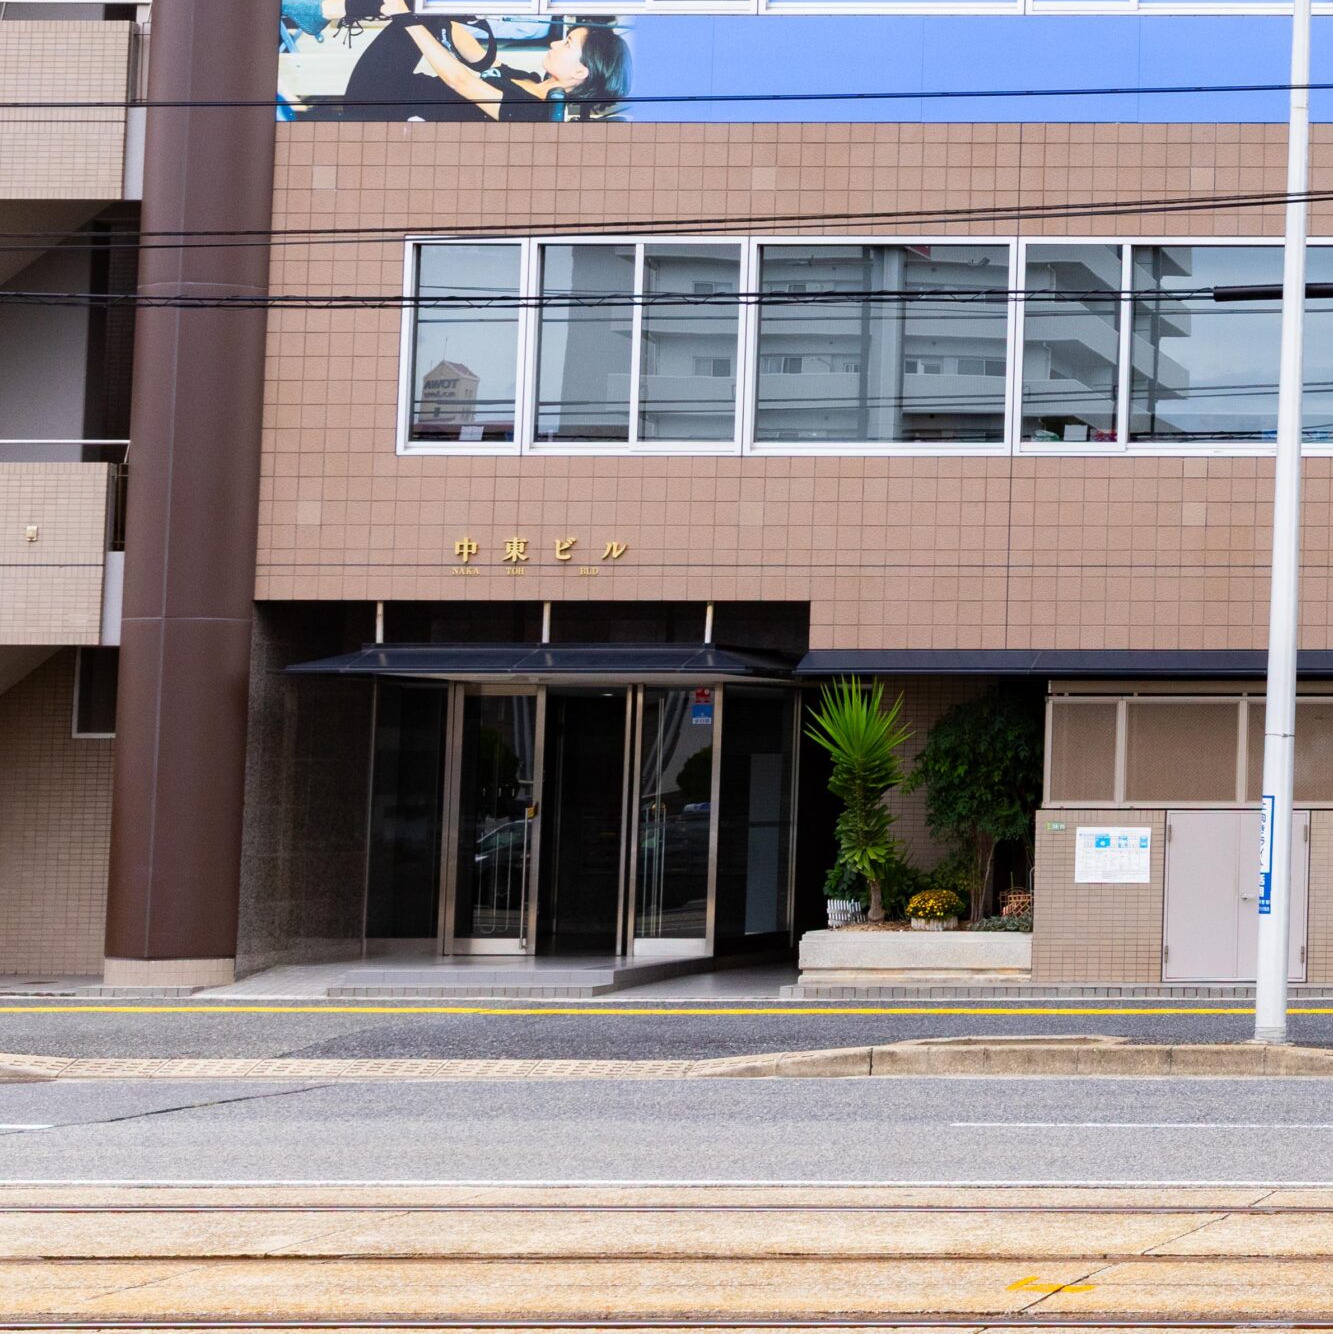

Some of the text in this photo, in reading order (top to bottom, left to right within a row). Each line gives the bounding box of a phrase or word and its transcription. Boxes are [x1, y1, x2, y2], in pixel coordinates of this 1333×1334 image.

[454, 537, 627, 563] 中東ビル
[452, 567, 480, 575] NAKA
[505, 567, 525, 575] TOH
